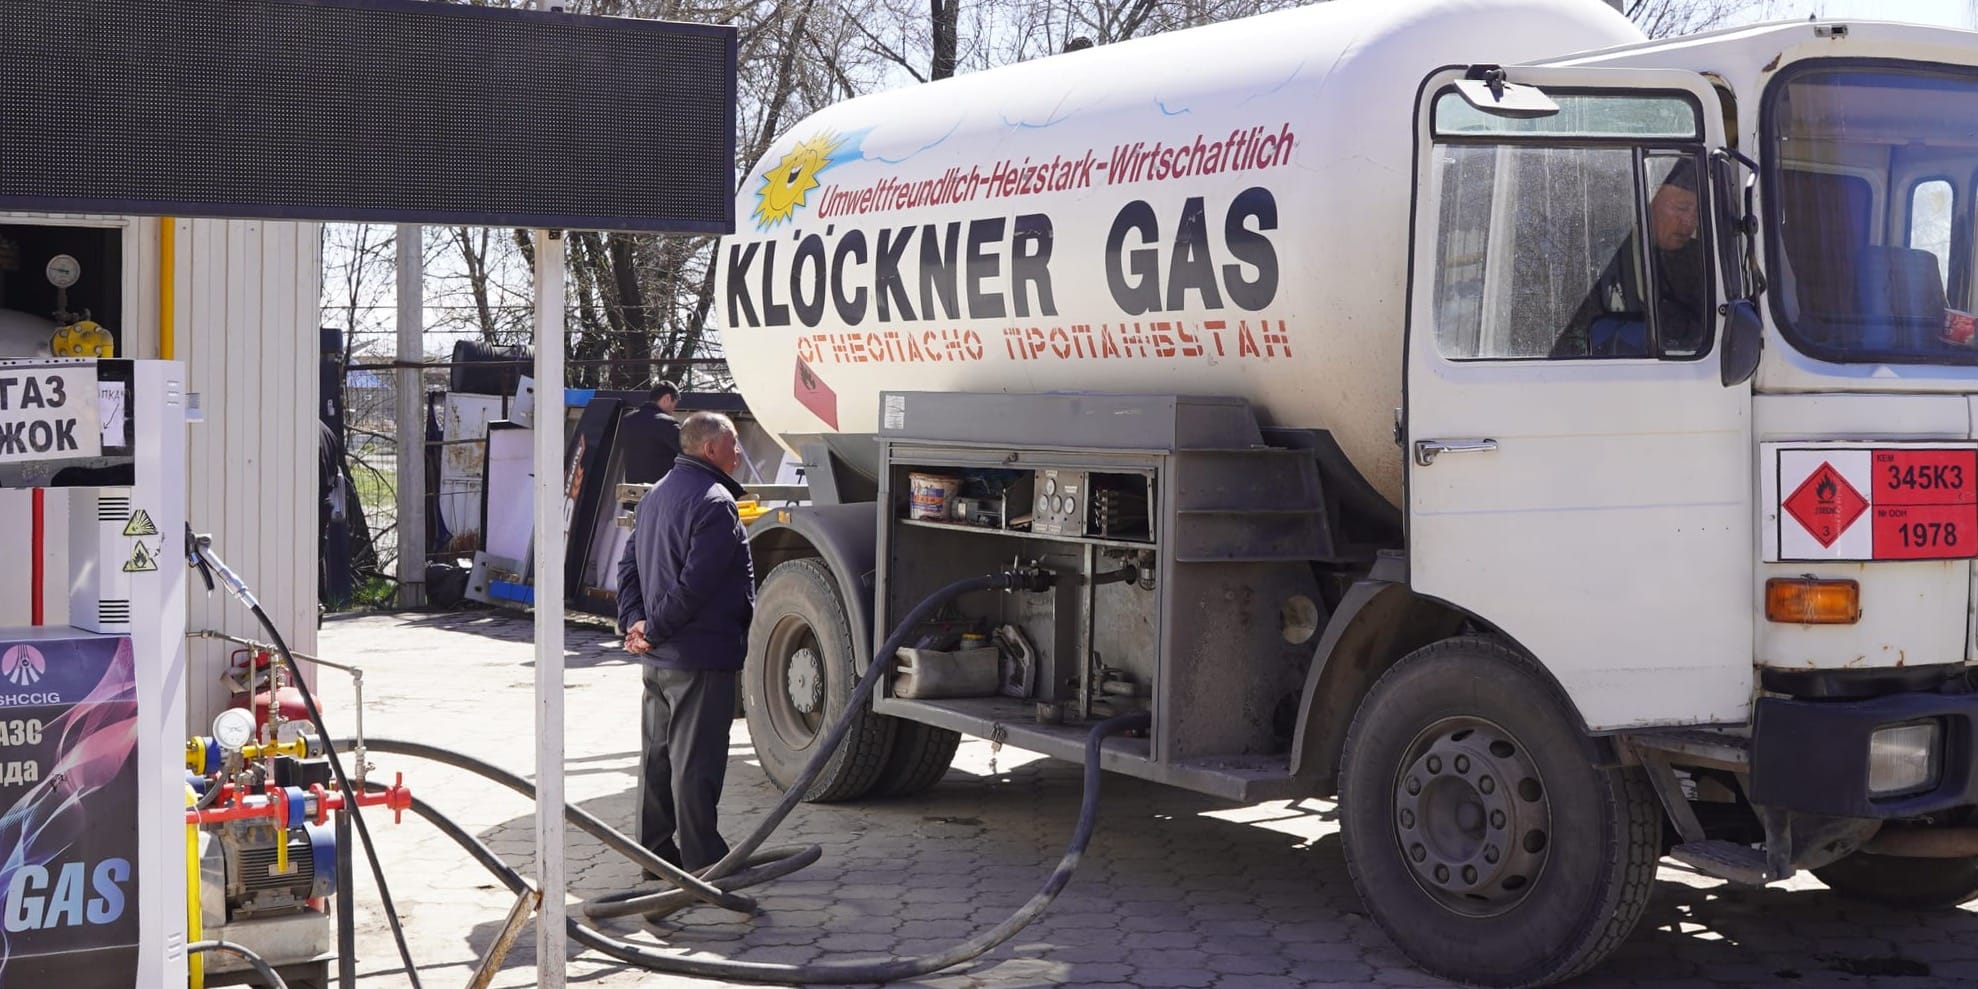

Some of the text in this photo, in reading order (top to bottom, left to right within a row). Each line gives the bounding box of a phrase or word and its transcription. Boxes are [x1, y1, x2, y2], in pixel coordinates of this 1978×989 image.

[726, 186, 1280, 328] KLÖCKNER GAS
[797, 329, 984, 364] ОГНЕОПАСНО
[0, 375, 67, 410] ГАЗ
[1822, 525, 1830, 537] 3
[1898, 522, 1957, 547] 1978
[0, 760, 38, 787] да
[4, 857, 131, 933] GAS
